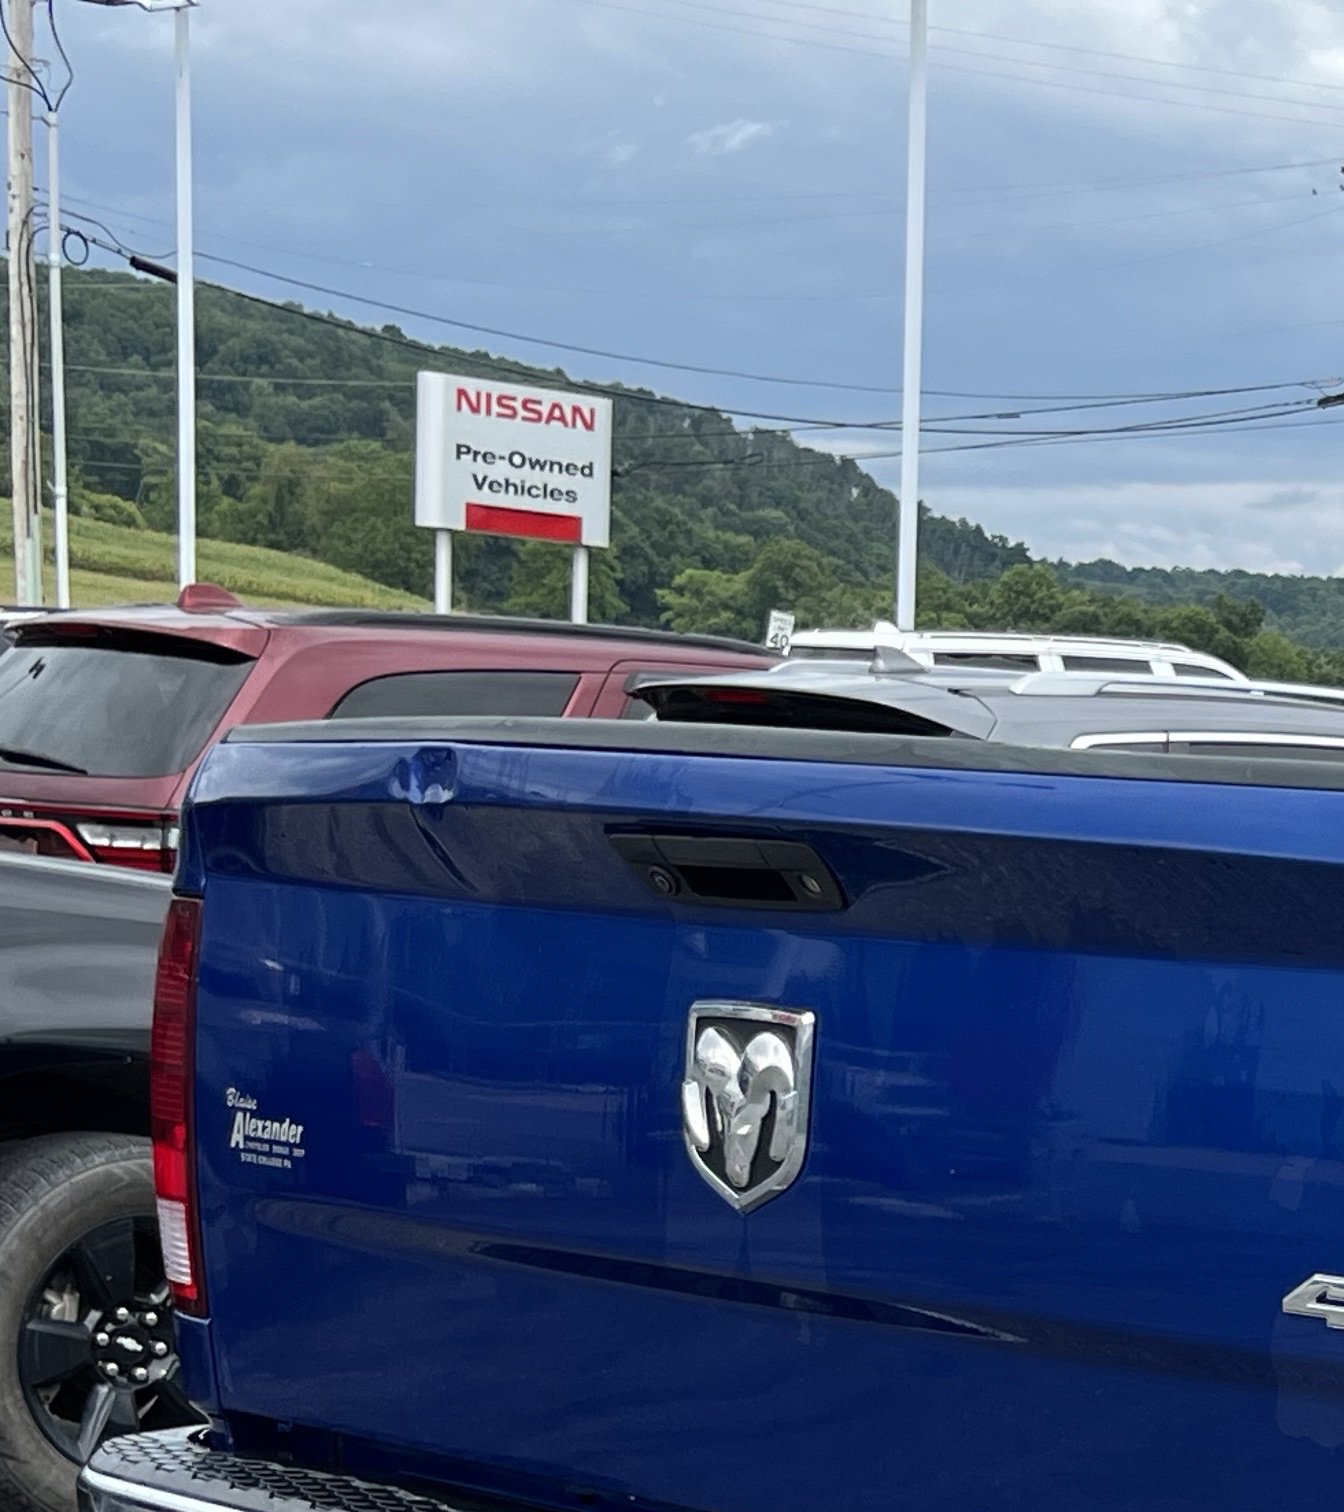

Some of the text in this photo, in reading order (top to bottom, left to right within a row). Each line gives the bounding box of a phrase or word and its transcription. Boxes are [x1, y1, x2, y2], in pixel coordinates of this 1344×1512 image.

[455, 387, 596, 432] NISSAN
[455, 443, 594, 478] Pre-Owned
[472, 473, 578, 503] Vehicles
[770, 633, 789, 648] 40
[230, 1111, 304, 1149] Alexander
